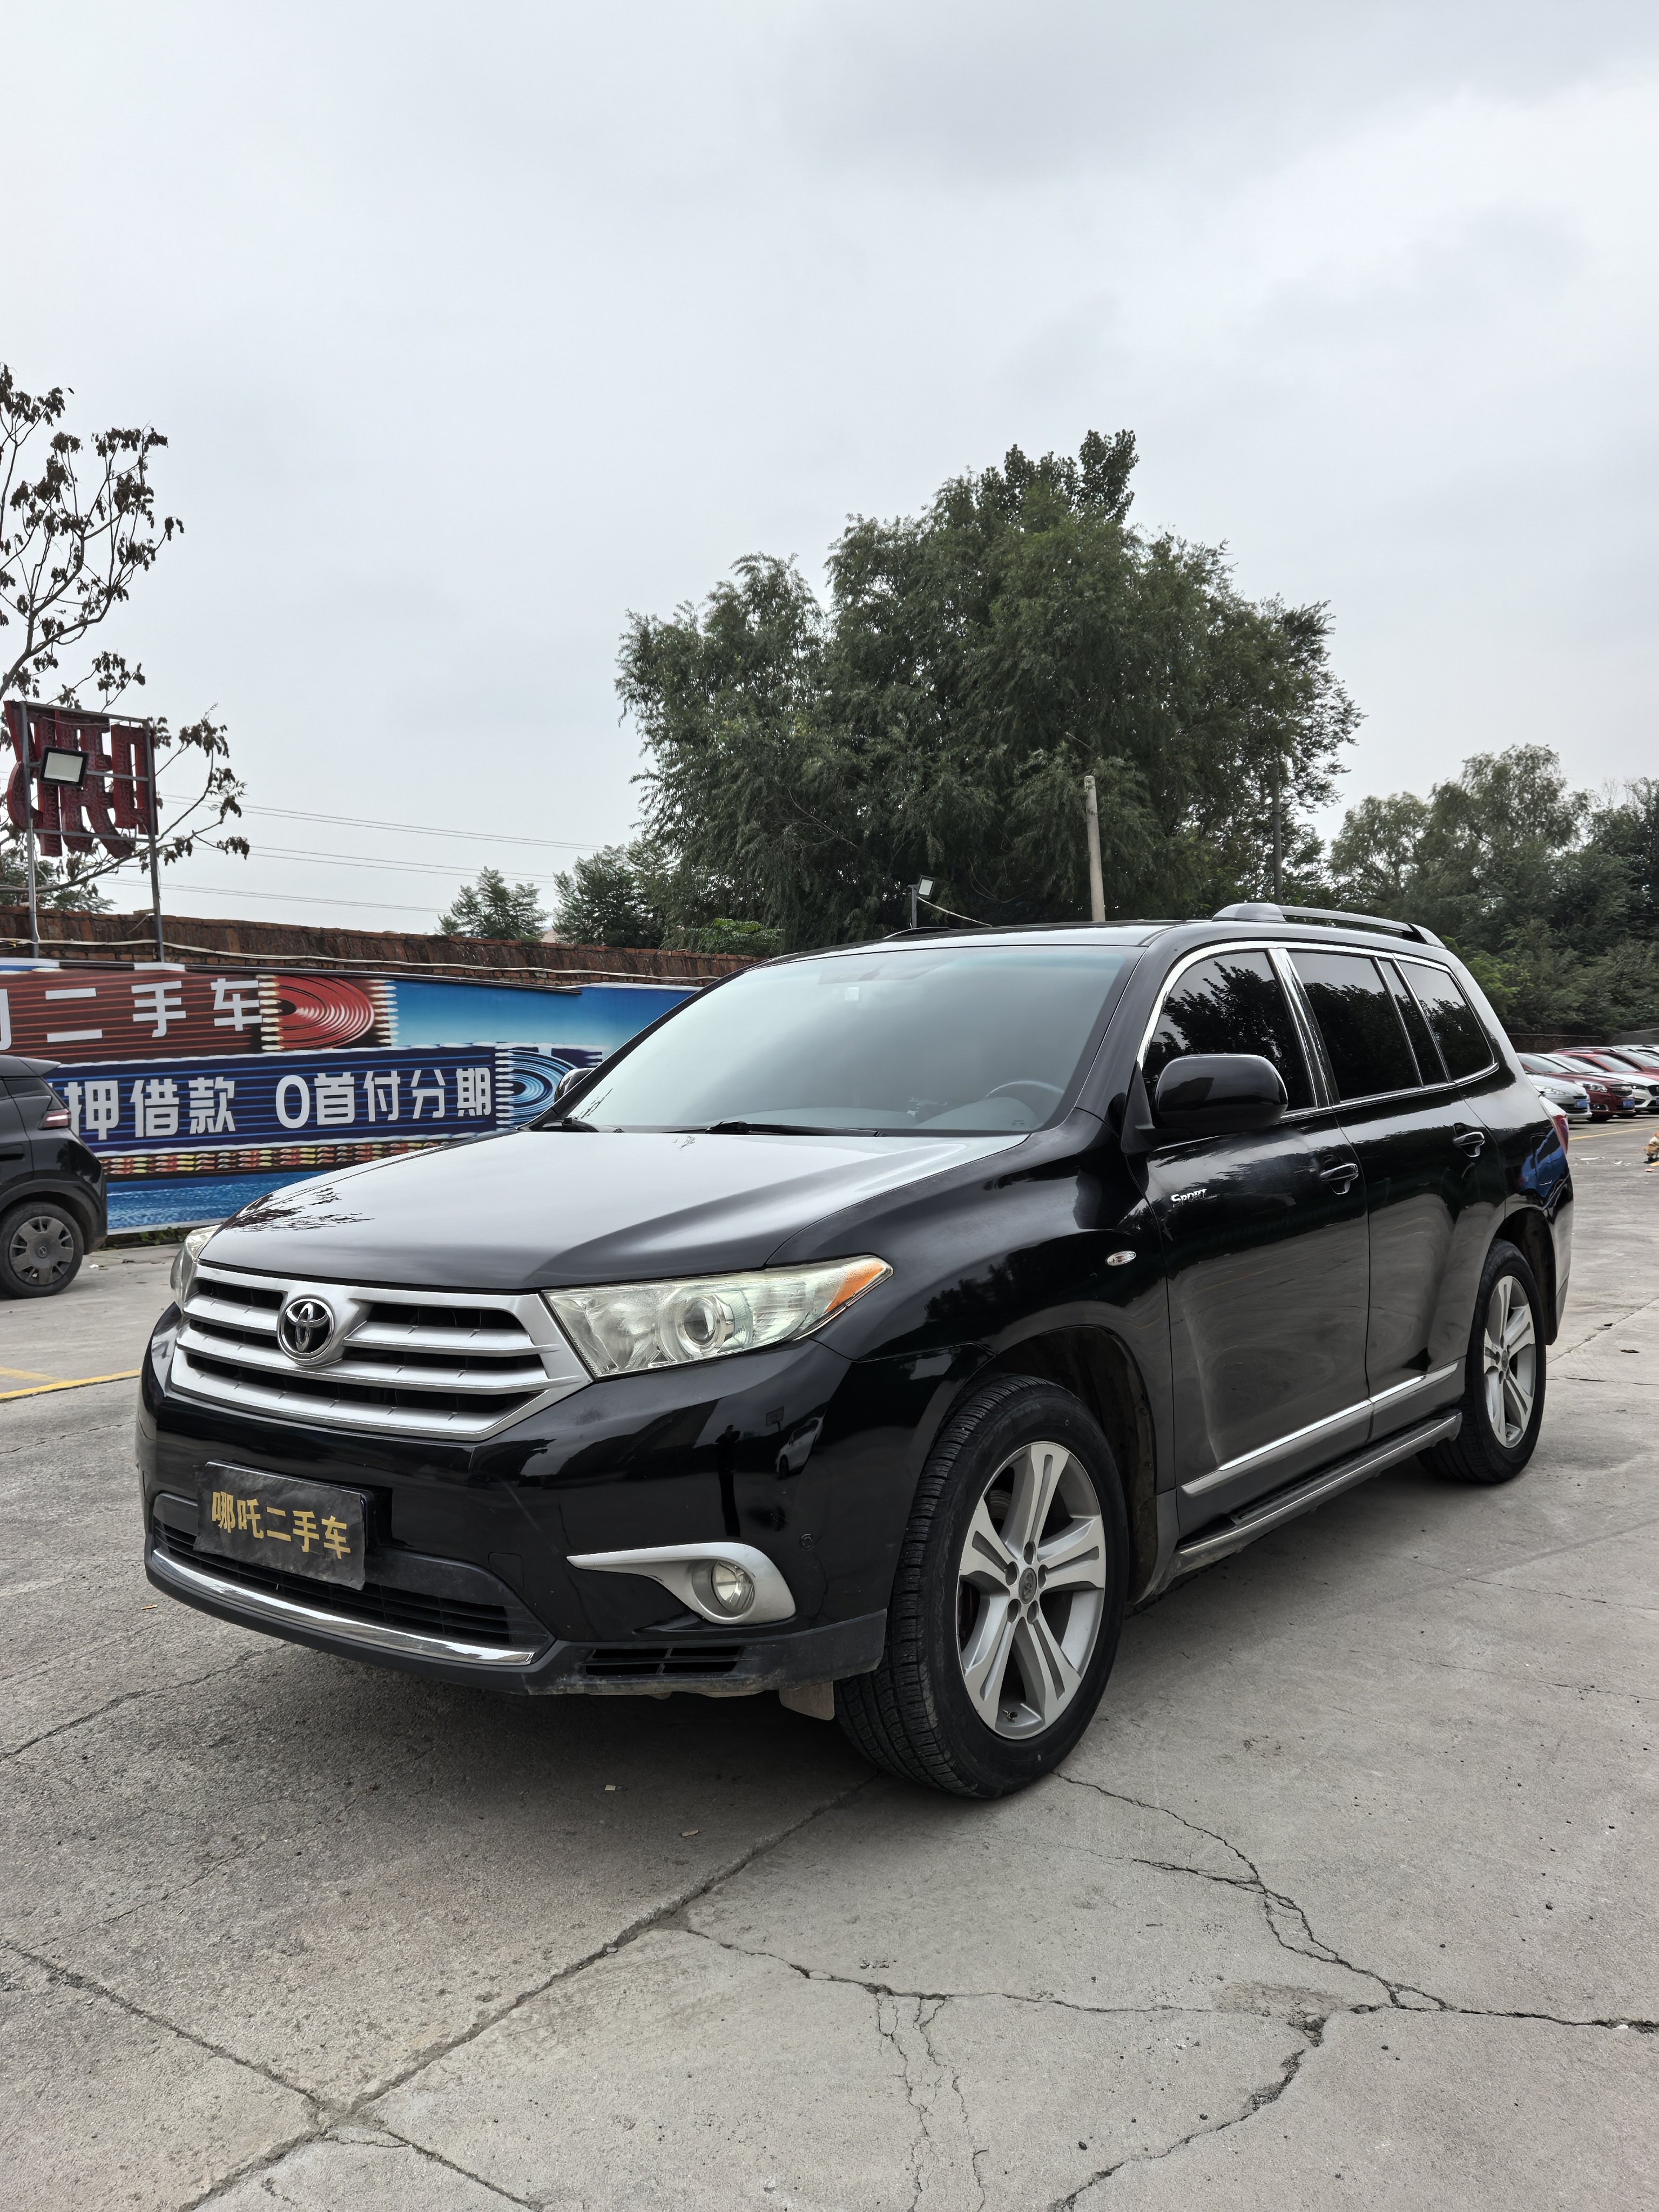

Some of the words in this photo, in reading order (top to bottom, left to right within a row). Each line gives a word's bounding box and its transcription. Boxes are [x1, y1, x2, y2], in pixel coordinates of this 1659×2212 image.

[0, 978, 262, 1050] 二手车
[48, 1076, 236, 1140] 押借款
[275, 1067, 491, 1128] 0首付分期
[1170, 1189, 1207, 1208] SPORT
[212, 1491, 351, 1559] 哪吒二手车
